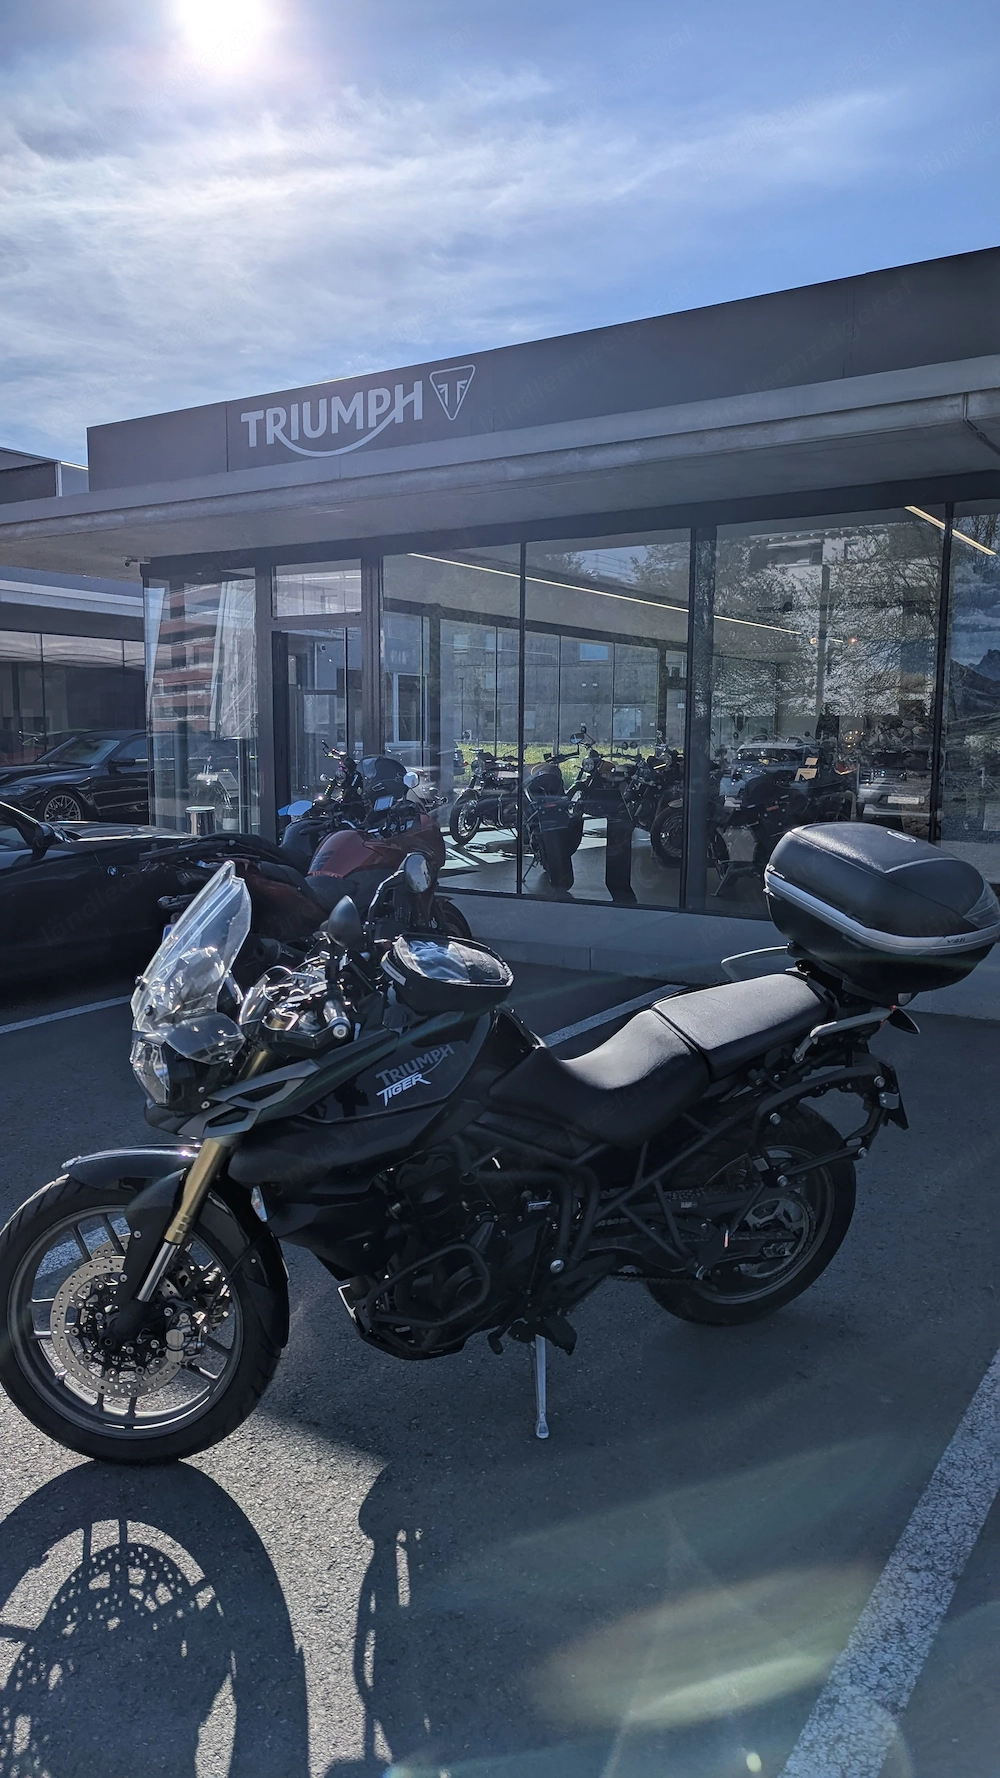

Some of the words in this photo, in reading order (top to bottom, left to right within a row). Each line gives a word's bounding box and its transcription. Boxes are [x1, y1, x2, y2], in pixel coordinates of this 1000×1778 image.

[241, 380, 423, 457] TRIUMPH
[375, 1044, 455, 1087] TRIUMPH
[376, 1072, 431, 1107] TIGER
